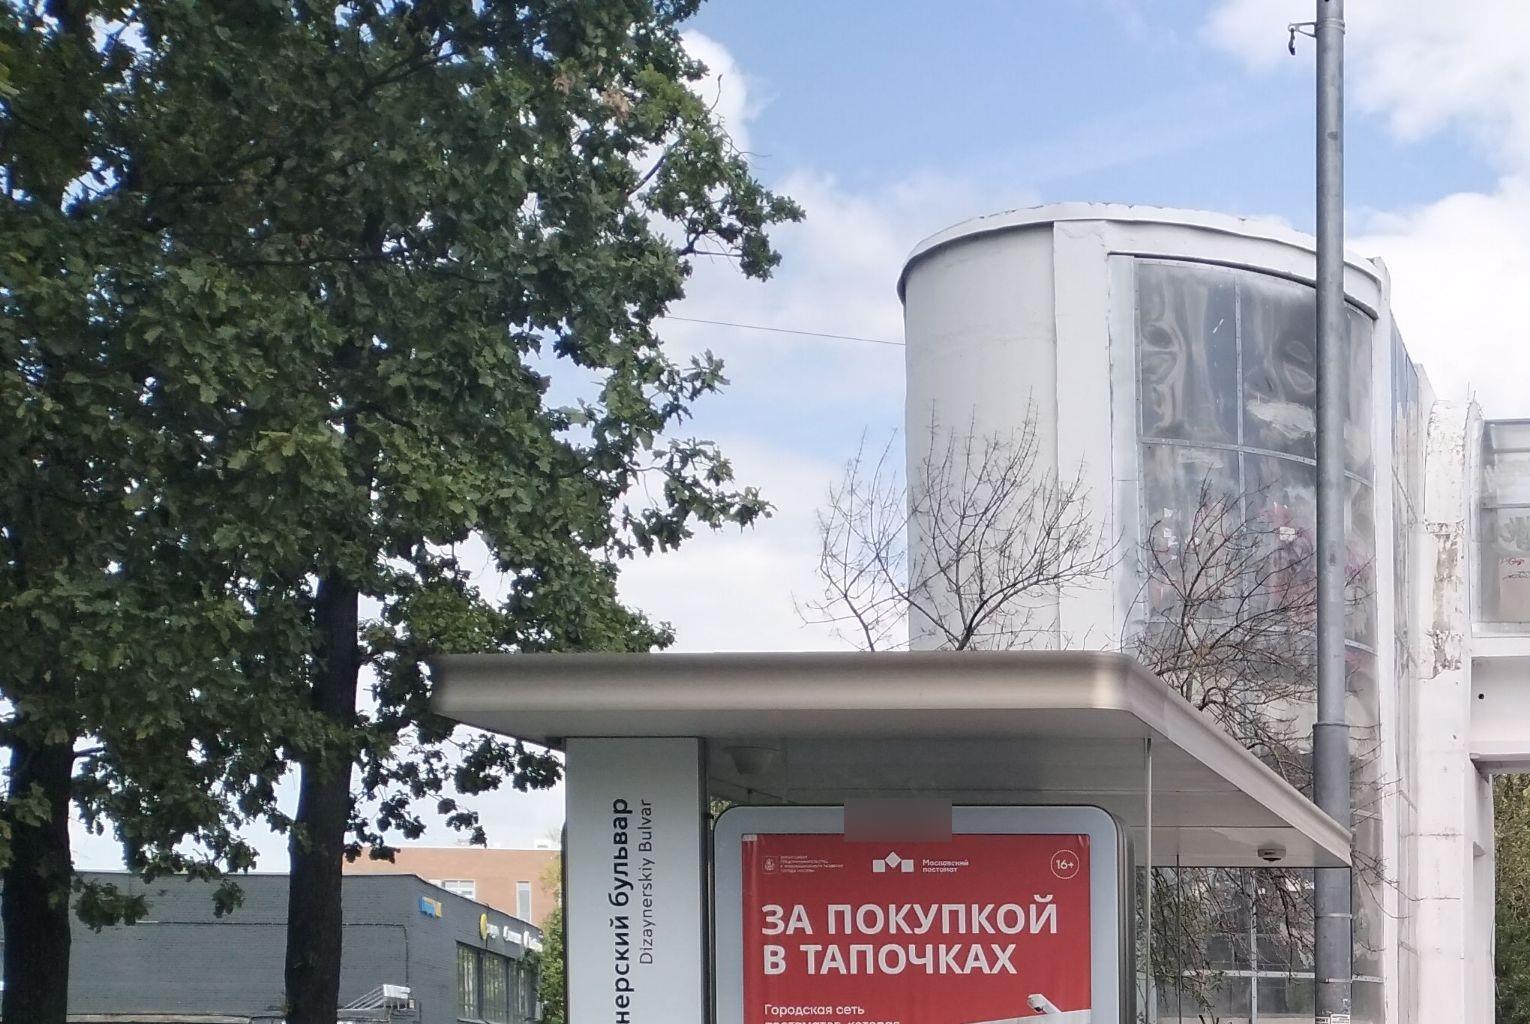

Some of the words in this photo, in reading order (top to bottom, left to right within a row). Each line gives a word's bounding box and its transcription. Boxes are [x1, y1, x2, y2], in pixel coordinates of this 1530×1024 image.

[637, 799, 652, 852] Bulvar
[608, 798, 634, 906] бульвар
[1056, 859, 1075, 870] 16+
[638, 857, 656, 964] Dizaynerskiy
[761, 904, 813, 935] ЗА
[827, 894, 1058, 935] ПОКУПКОЙ
[763, 944, 787, 975] В
[800, 943, 1018, 975] ТАПОЧКАХ
[764, 1004, 833, 1017] Городская
[835, 1006, 865, 1015] сеть
